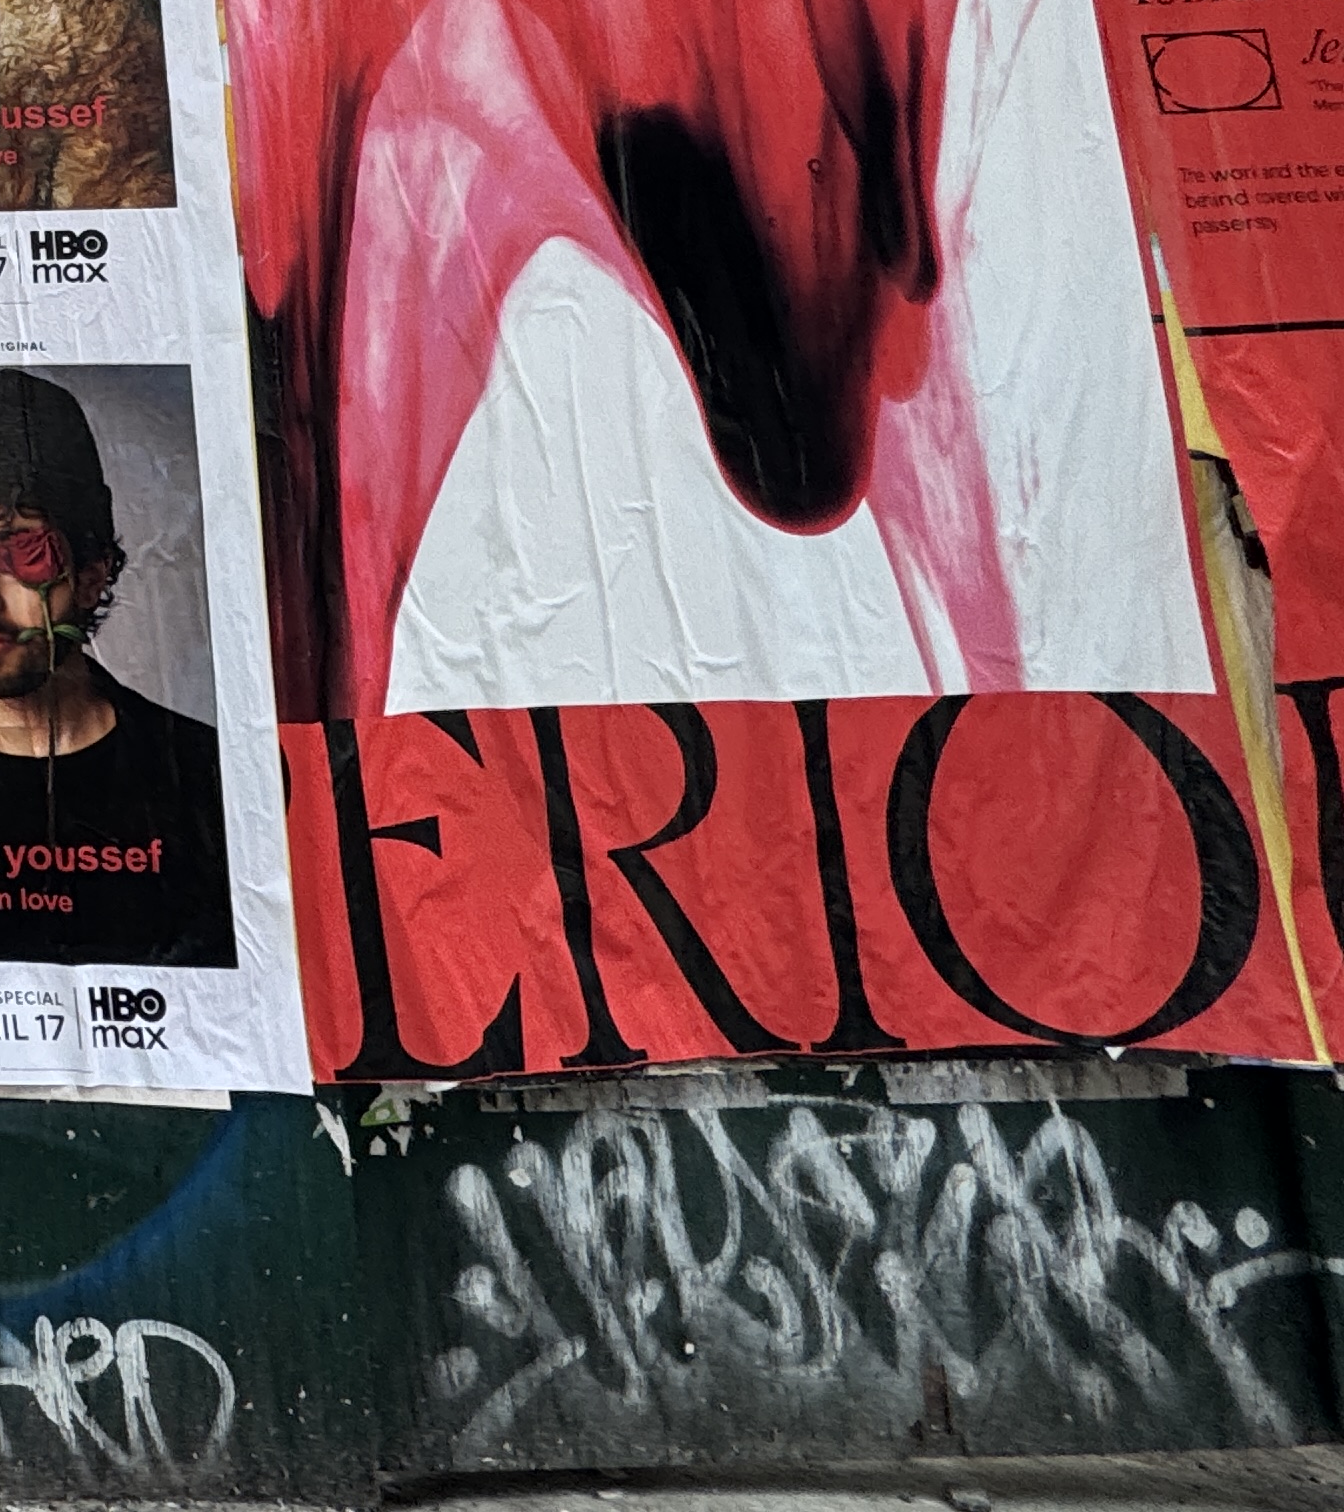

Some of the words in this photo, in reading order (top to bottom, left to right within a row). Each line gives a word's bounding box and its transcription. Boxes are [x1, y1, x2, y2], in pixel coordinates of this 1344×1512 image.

[29, 229, 109, 261] HBO
[31, 261, 110, 284] max
[3, 838, 163, 879] youssef
[285, 681, 1344, 1085] ERIO
[20, 888, 73, 913] love
[87, 986, 167, 1023] HBO
[34, 1014, 65, 1043] 17
[91, 1023, 169, 1050] max
